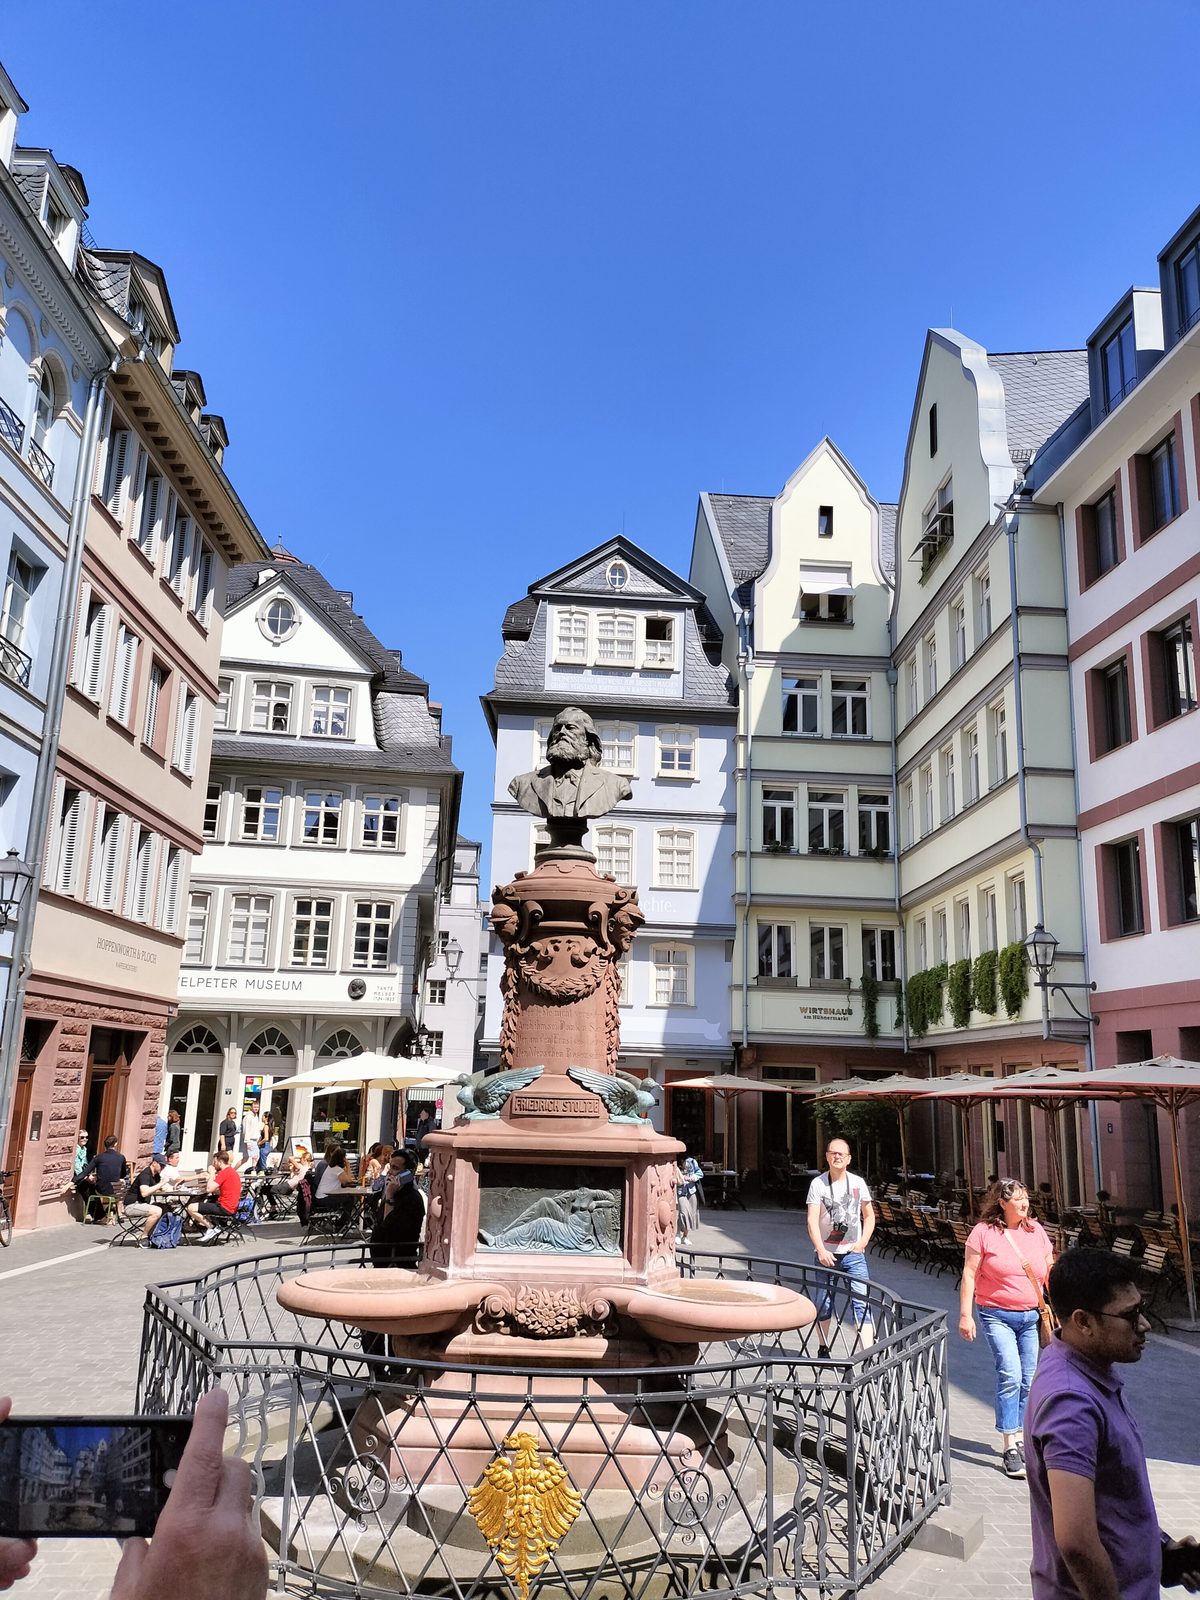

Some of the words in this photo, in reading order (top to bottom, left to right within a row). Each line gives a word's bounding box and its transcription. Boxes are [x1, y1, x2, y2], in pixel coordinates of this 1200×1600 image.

[96, 937, 137, 958] HOPPENWORTH
[141, 950, 157, 964] PLOCH
[245, 979, 302, 991] MUSEUM
[799, 1007, 853, 1016] WIRTSHAUS
[514, 1097, 559, 1112] FRIEDRICH
[562, 1099, 599, 1113] STOLTZE
